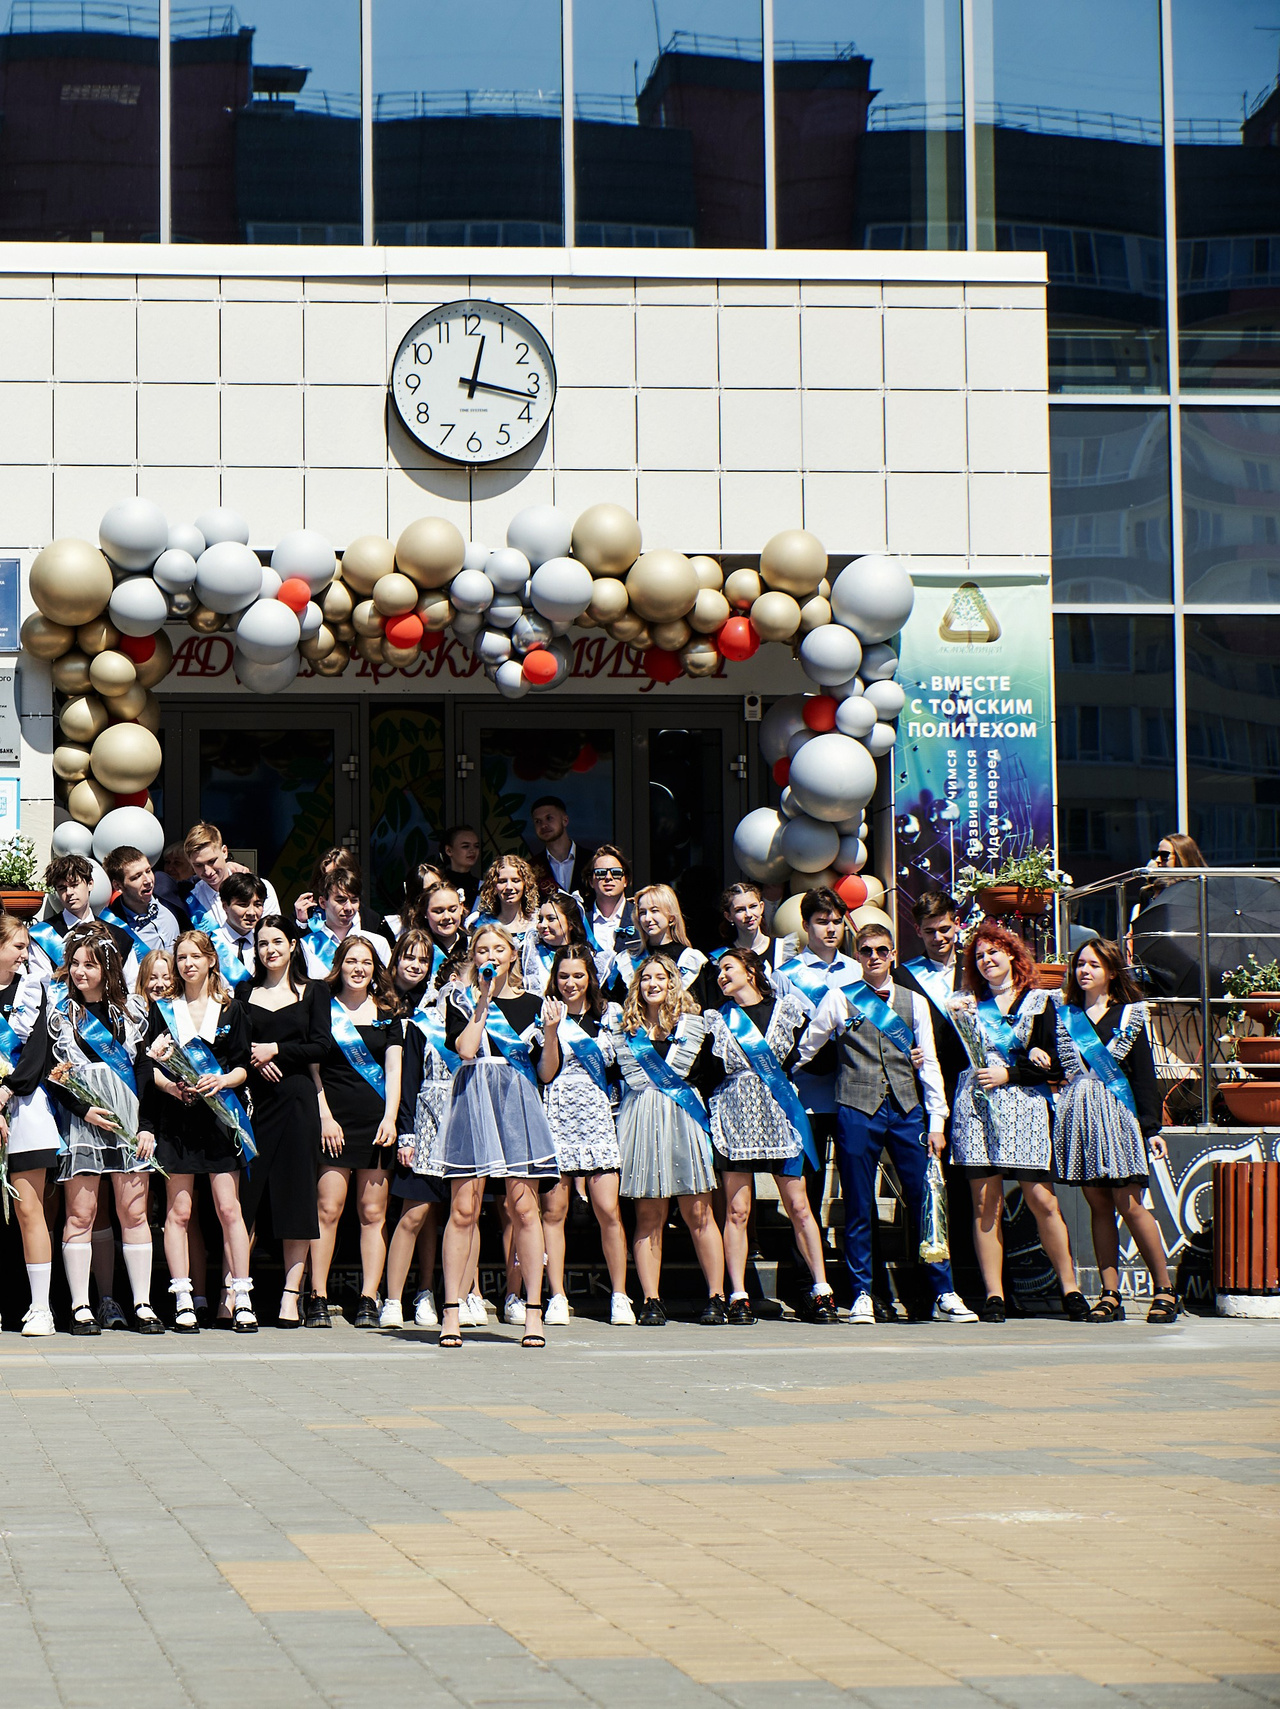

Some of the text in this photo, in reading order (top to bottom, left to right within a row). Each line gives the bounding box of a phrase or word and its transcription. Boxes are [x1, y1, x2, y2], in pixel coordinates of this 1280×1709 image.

[436, 322, 449, 343] 11
[462, 314, 481, 336] 12
[499, 322, 503, 343] 1
[412, 343, 432, 364] 10
[516, 343, 529, 364] 2
[405, 374, 421, 395] 9
[527, 373, 540, 394] 3
[417, 402, 429, 423] 8
[517, 402, 532, 423] 4
[440, 424, 455, 445] 7
[467, 432, 482, 452] 6
[496, 424, 510, 445] 5
[931, 676, 1011, 691] ВМЕСТЕ
[910, 699, 1033, 714] С ТОМСКИМ
[908, 722, 1037, 738] ПОЛИТЕХОМ
[945, 750, 957, 810] Учимся
[967, 750, 978, 858] Развиваемся
[987, 749, 1000, 859] Идем вперед
